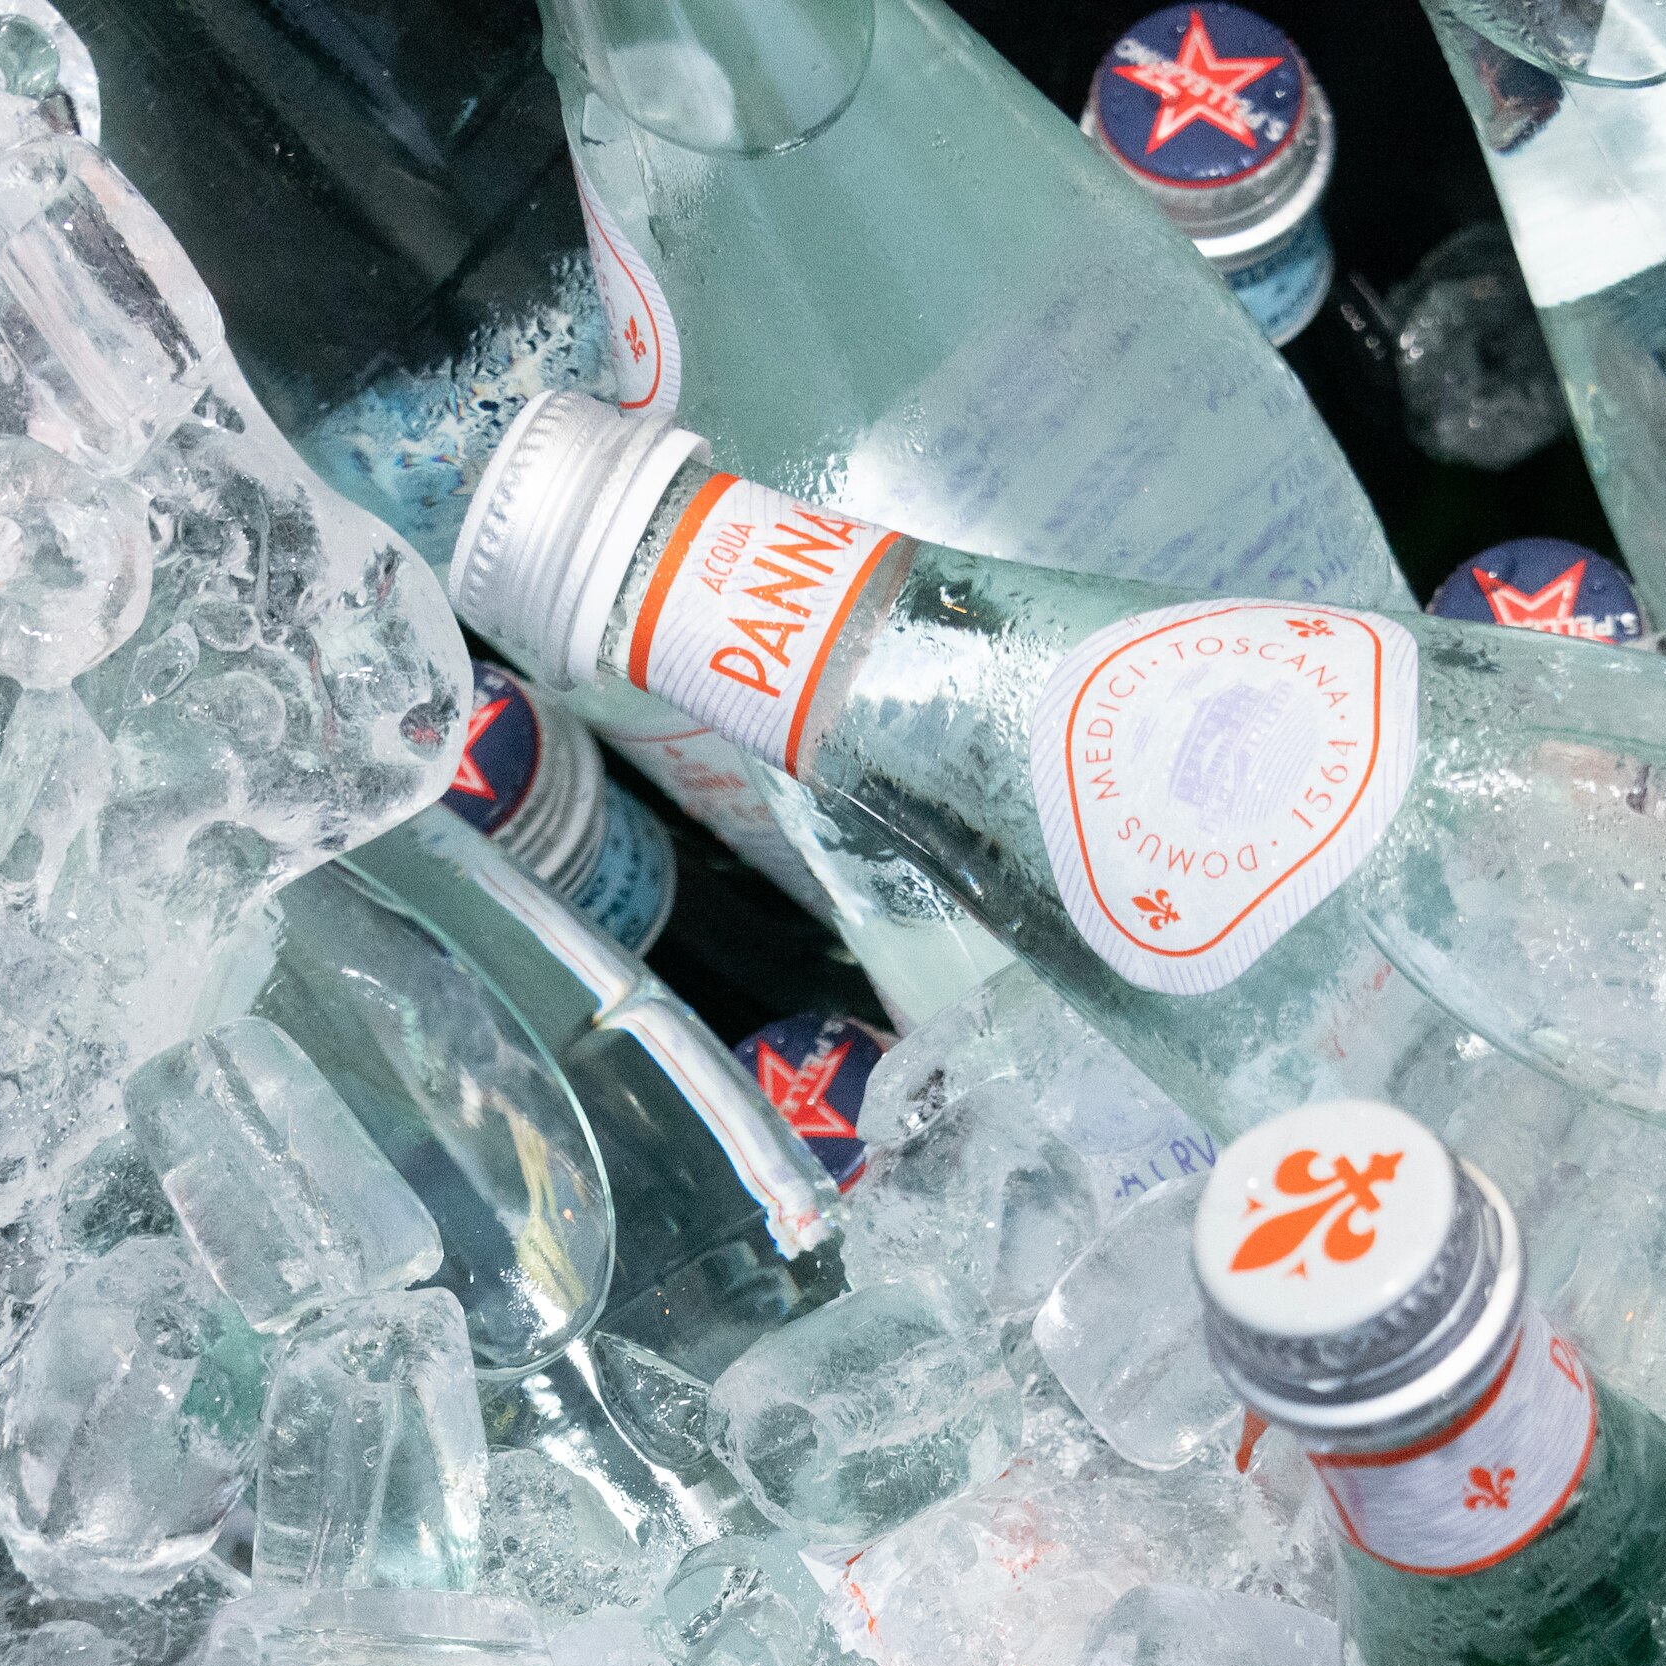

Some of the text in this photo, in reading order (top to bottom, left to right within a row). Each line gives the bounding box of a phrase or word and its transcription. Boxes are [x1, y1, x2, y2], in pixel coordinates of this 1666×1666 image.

[700, 522, 756, 596] ACQUA
[709, 508, 867, 699] PANNA
[1085, 636, 1358, 879] DOMUS MEDICI TOSCANA 1564
